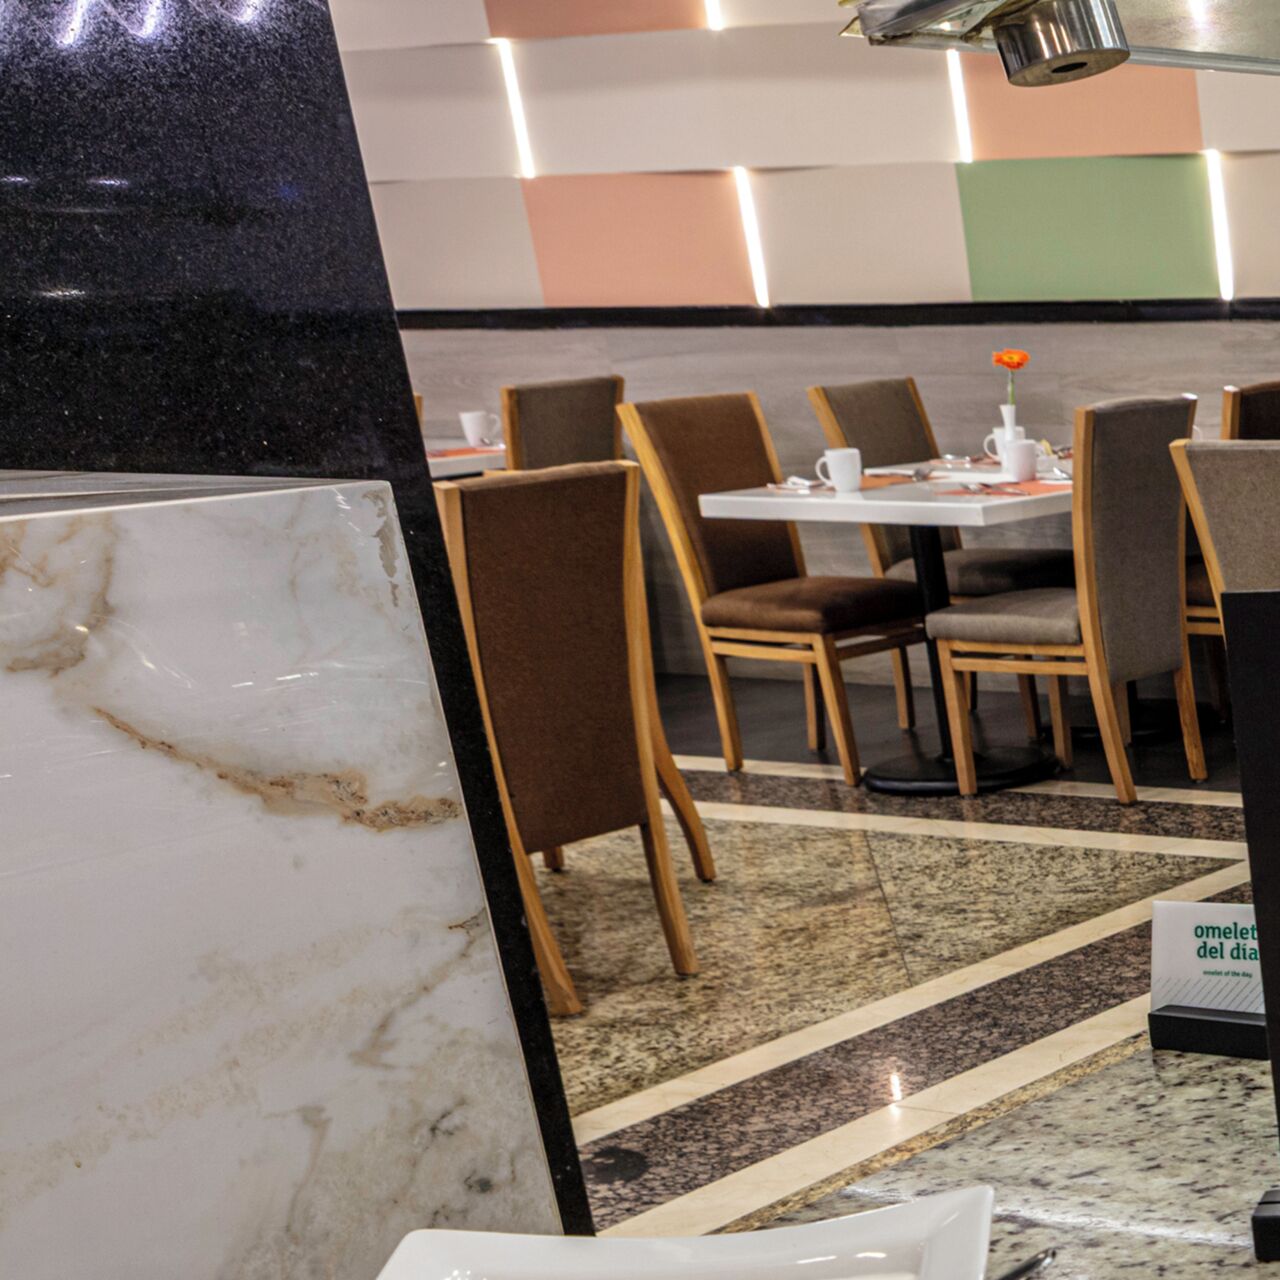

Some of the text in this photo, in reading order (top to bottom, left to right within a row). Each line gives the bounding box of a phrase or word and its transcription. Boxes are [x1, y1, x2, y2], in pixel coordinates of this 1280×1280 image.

[1194, 921, 1259, 941] omelet
[1196, 941, 1260, 961] del día
